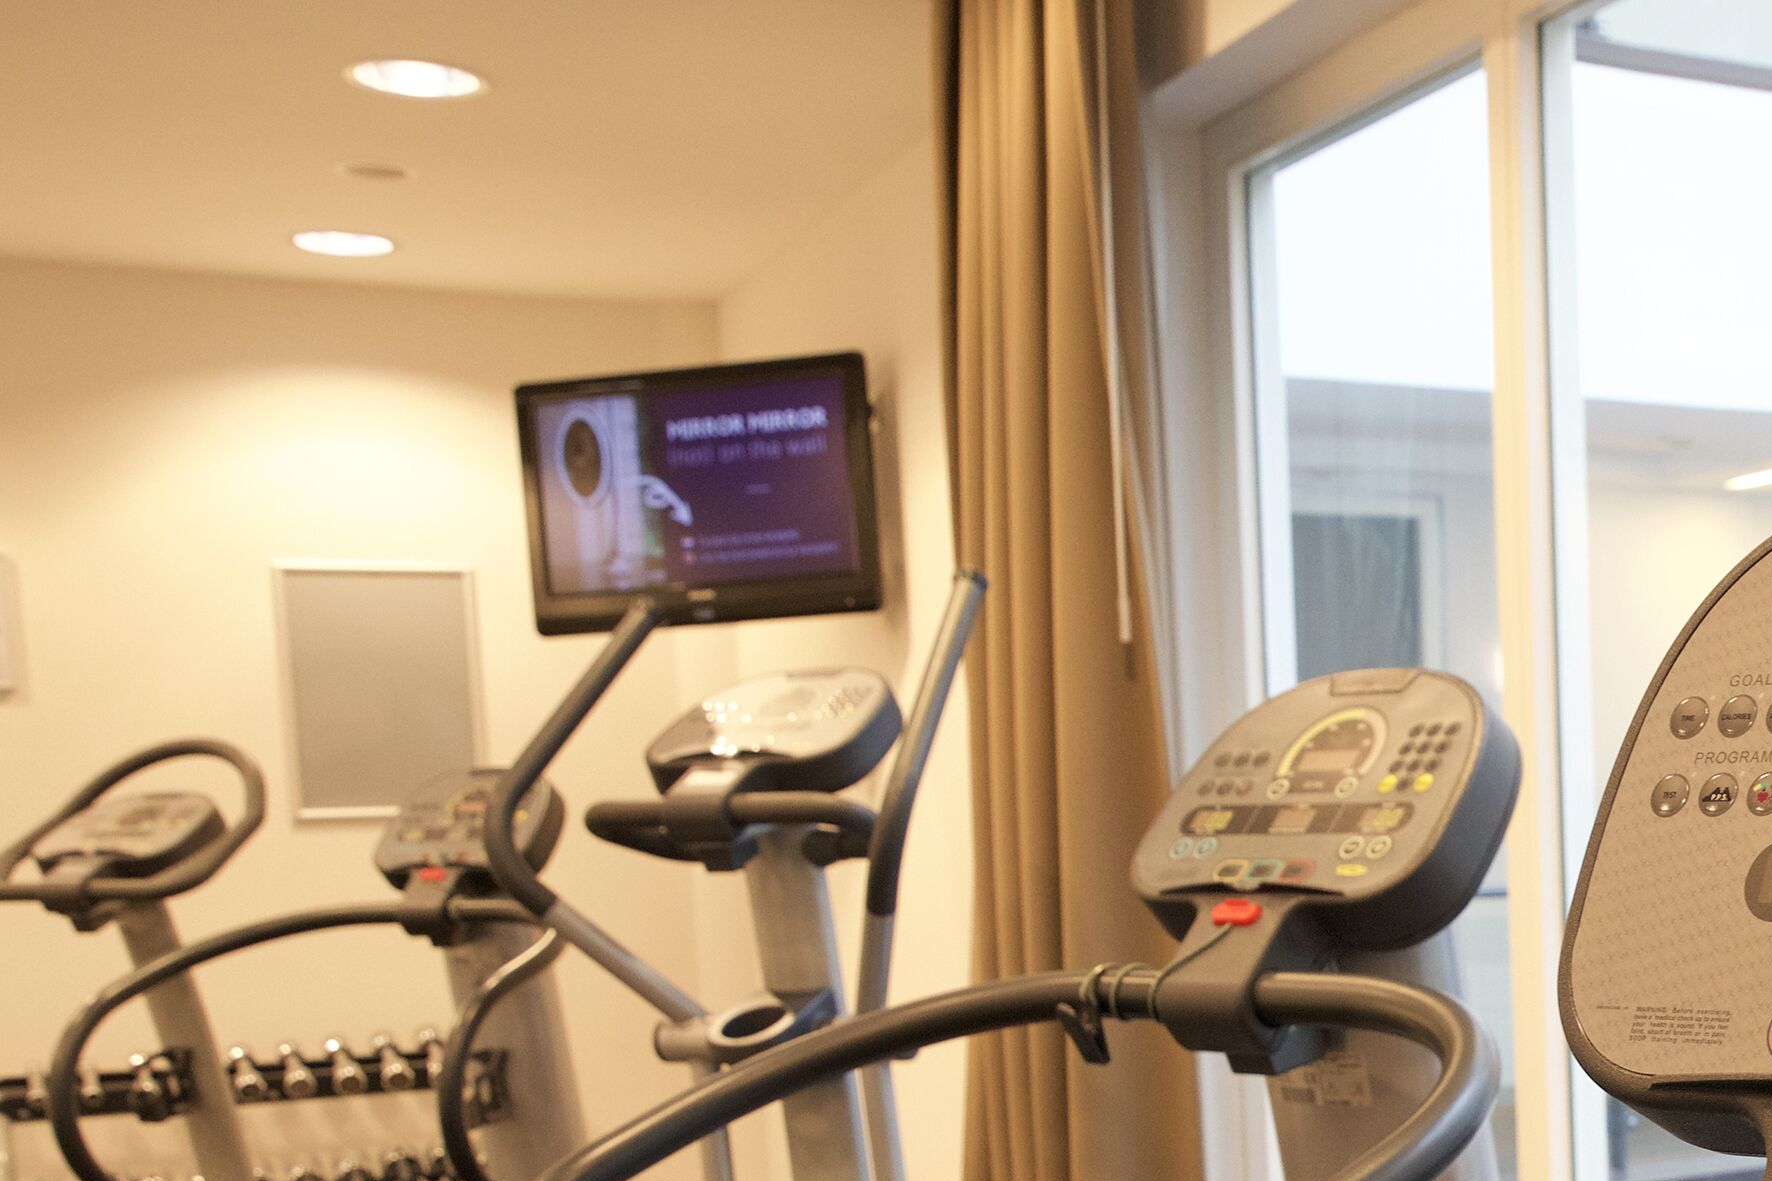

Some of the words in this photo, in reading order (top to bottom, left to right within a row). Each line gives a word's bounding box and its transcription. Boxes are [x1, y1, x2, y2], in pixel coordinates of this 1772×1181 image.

[666, 413, 745, 442] MIRROR
[747, 406, 829, 433] MIRROR
[1720, 713, 1752, 721] CALORIES
